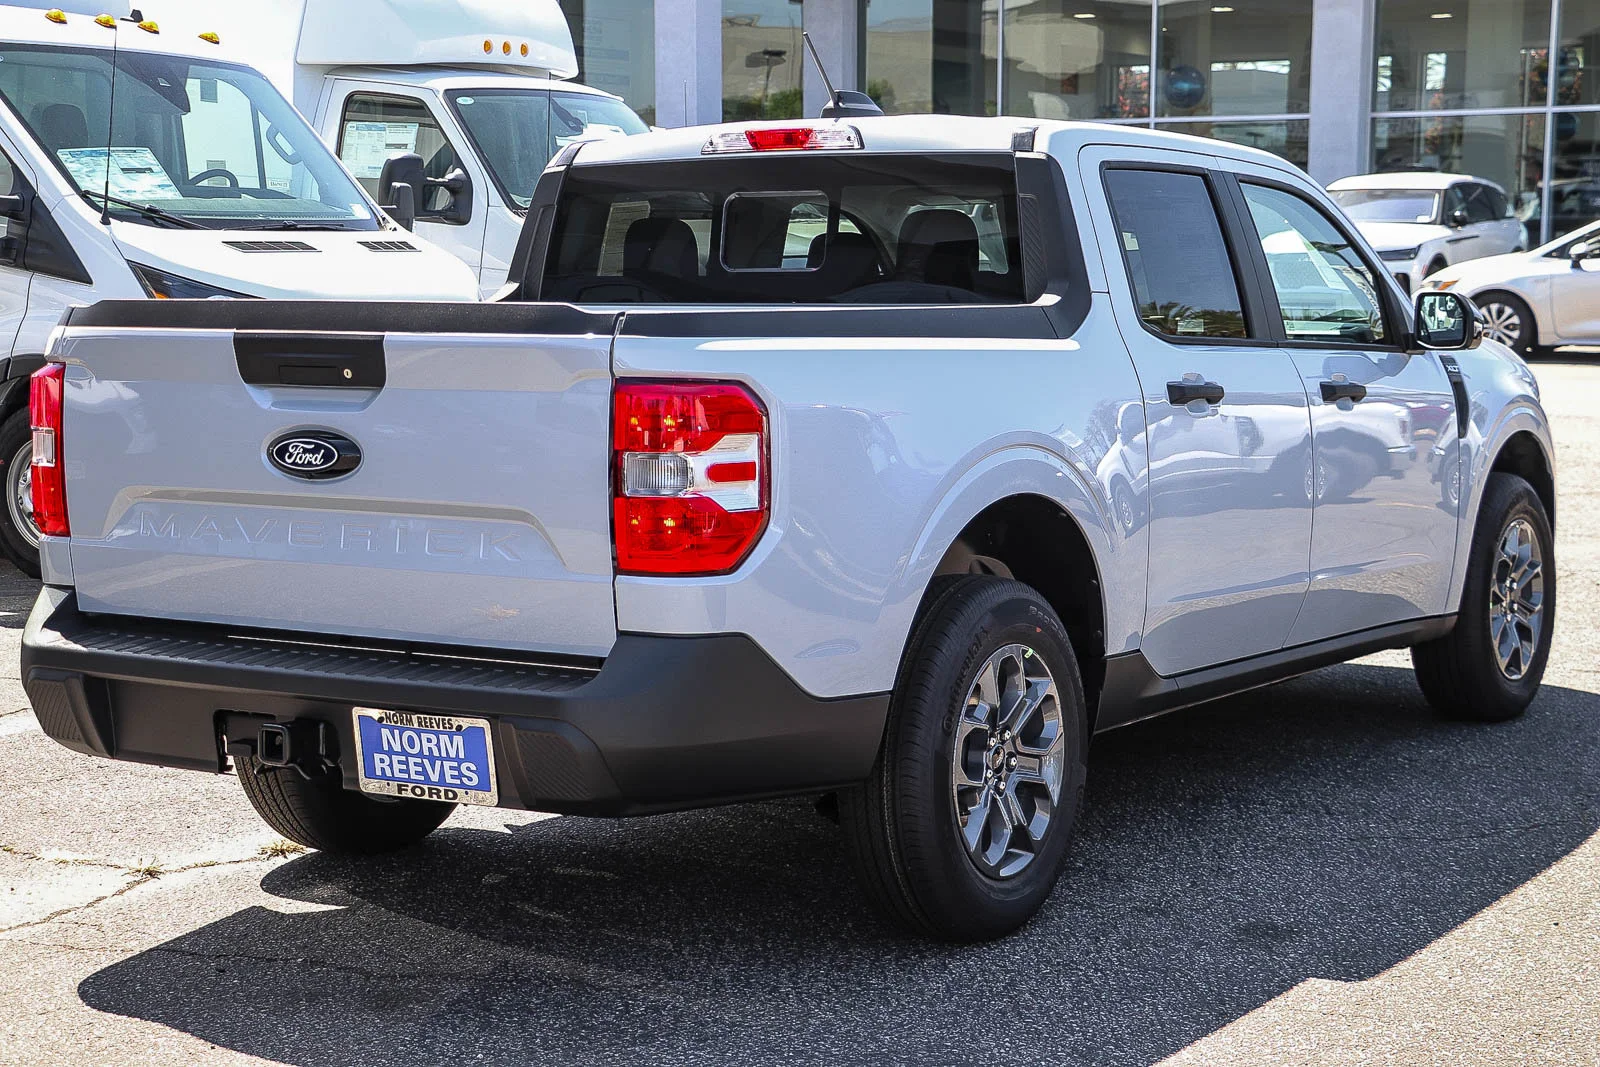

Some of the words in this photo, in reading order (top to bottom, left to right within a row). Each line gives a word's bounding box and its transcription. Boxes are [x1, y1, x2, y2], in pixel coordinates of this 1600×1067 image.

[285, 442, 325, 465] Ford
[139, 511, 522, 562] MAVERICK
[384, 711, 414, 727] NORM
[417, 715, 454, 730] REEVES
[380, 728, 465, 759] NORM
[373, 752, 479, 786] REEVES
[396, 783, 459, 801] FORD
